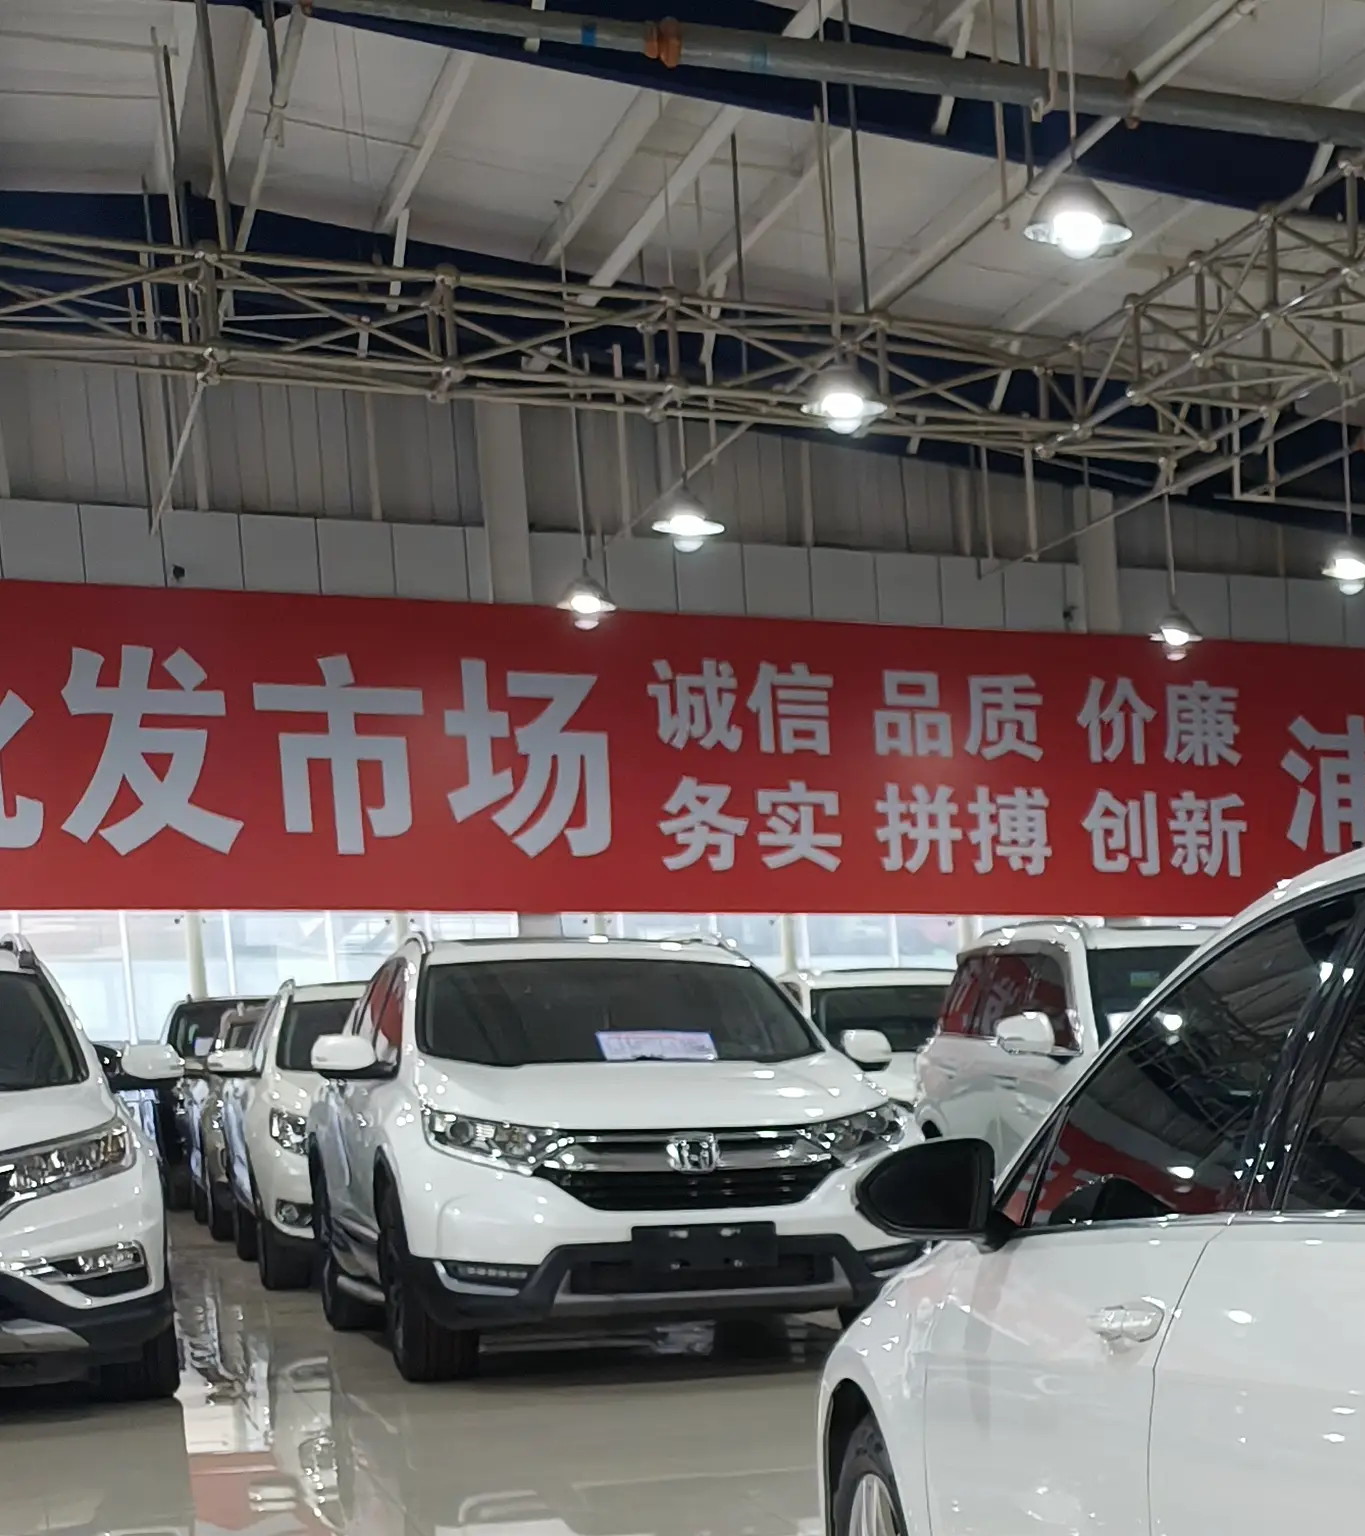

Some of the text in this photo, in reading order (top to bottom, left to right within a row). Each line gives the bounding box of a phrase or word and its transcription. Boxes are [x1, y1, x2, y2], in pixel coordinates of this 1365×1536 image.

[647, 657, 1242, 767] 诚信 品质 价廉
[658, 775, 1247, 877] 务实 拼搏 创新
